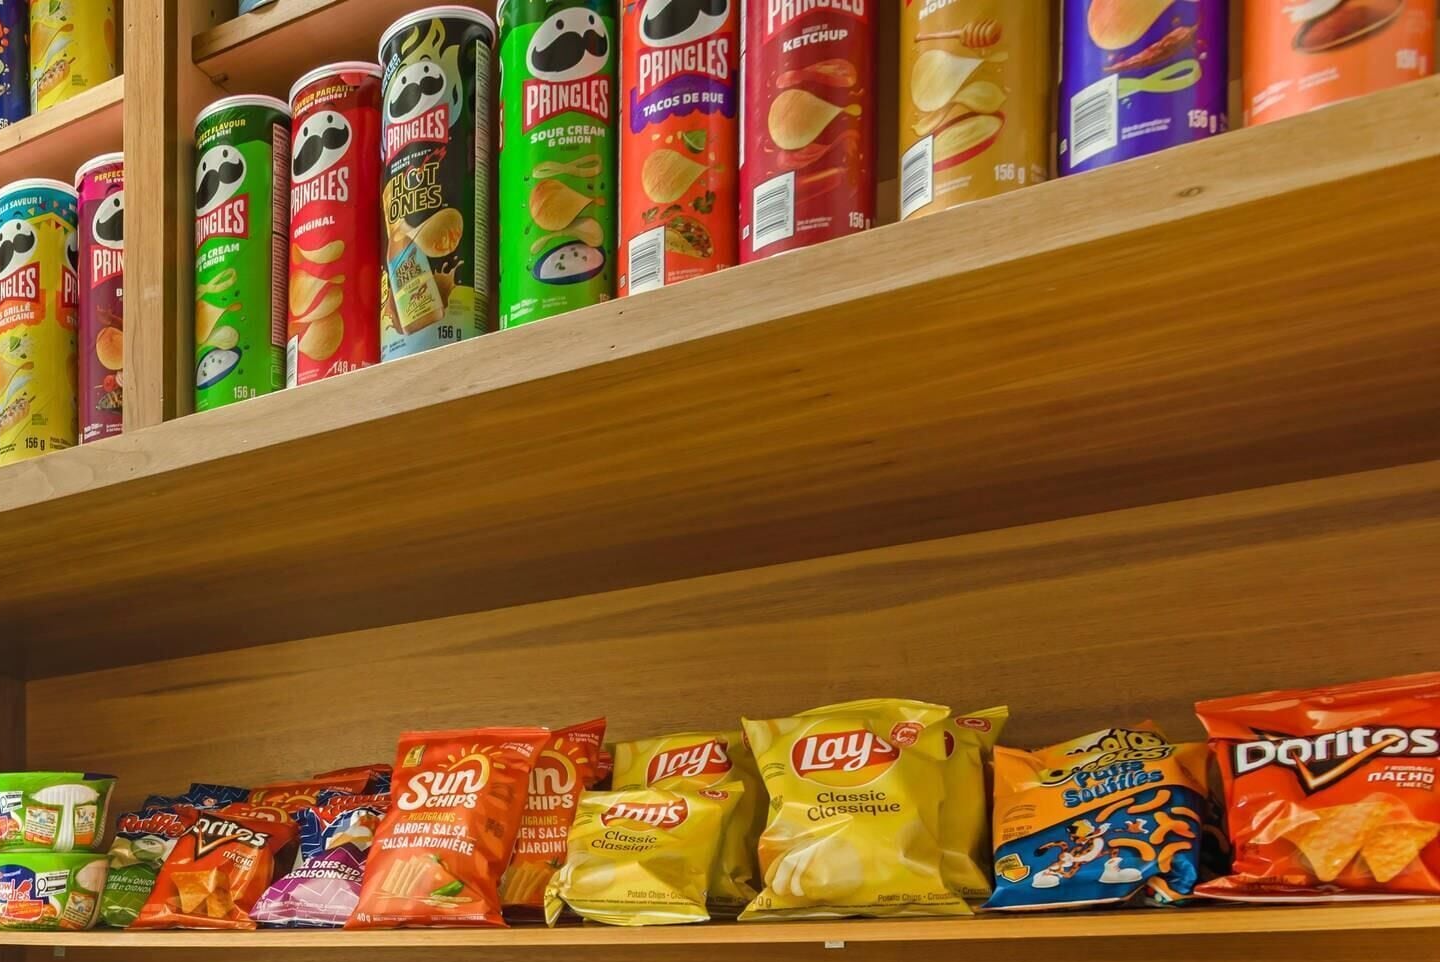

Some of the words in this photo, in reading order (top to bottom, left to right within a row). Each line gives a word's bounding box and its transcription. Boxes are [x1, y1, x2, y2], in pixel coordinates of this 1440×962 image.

[782, 29, 848, 53] KETCHUP
[639, 37, 729, 96] PRINGLES
[525, 83, 609, 129] PRINGLES
[643, 96, 680, 118] TACOS
[682, 92, 700, 104] DE
[703, 92, 724, 105] RUE
[212, 119, 246, 134] FLAVOUR
[1188, 109, 1208, 129] 156
[387, 109, 445, 159] PRINGLES
[530, 129, 558, 145] SOUR
[560, 124, 606, 139] CREAM
[558, 134, 591, 146] ONION
[994, 164, 1015, 182] 156
[291, 166, 349, 223] PRINGLES
[389, 185, 442, 224] ONES
[294, 215, 335, 238] ORIGINAL
[437, 324, 454, 339] 156
[25, 437, 37, 449] 156
[1235, 727, 1440, 774] Doritos
[398, 766, 483, 811] Sun
[816, 789, 886, 804] Classic
[1061, 769, 1164, 809] Soufflés
[426, 794, 478, 809] CHIPS
[806, 803, 901, 822] Classique
[393, 824, 430, 837] GARDEN
[432, 826, 468, 839] SALSA
[604, 830, 657, 845] Classic
[381, 838, 408, 851] SALSA
[409, 835, 474, 857] JARDINIÈRE
[878, 893, 901, 903] Potato
[903, 893, 921, 902] Chips
